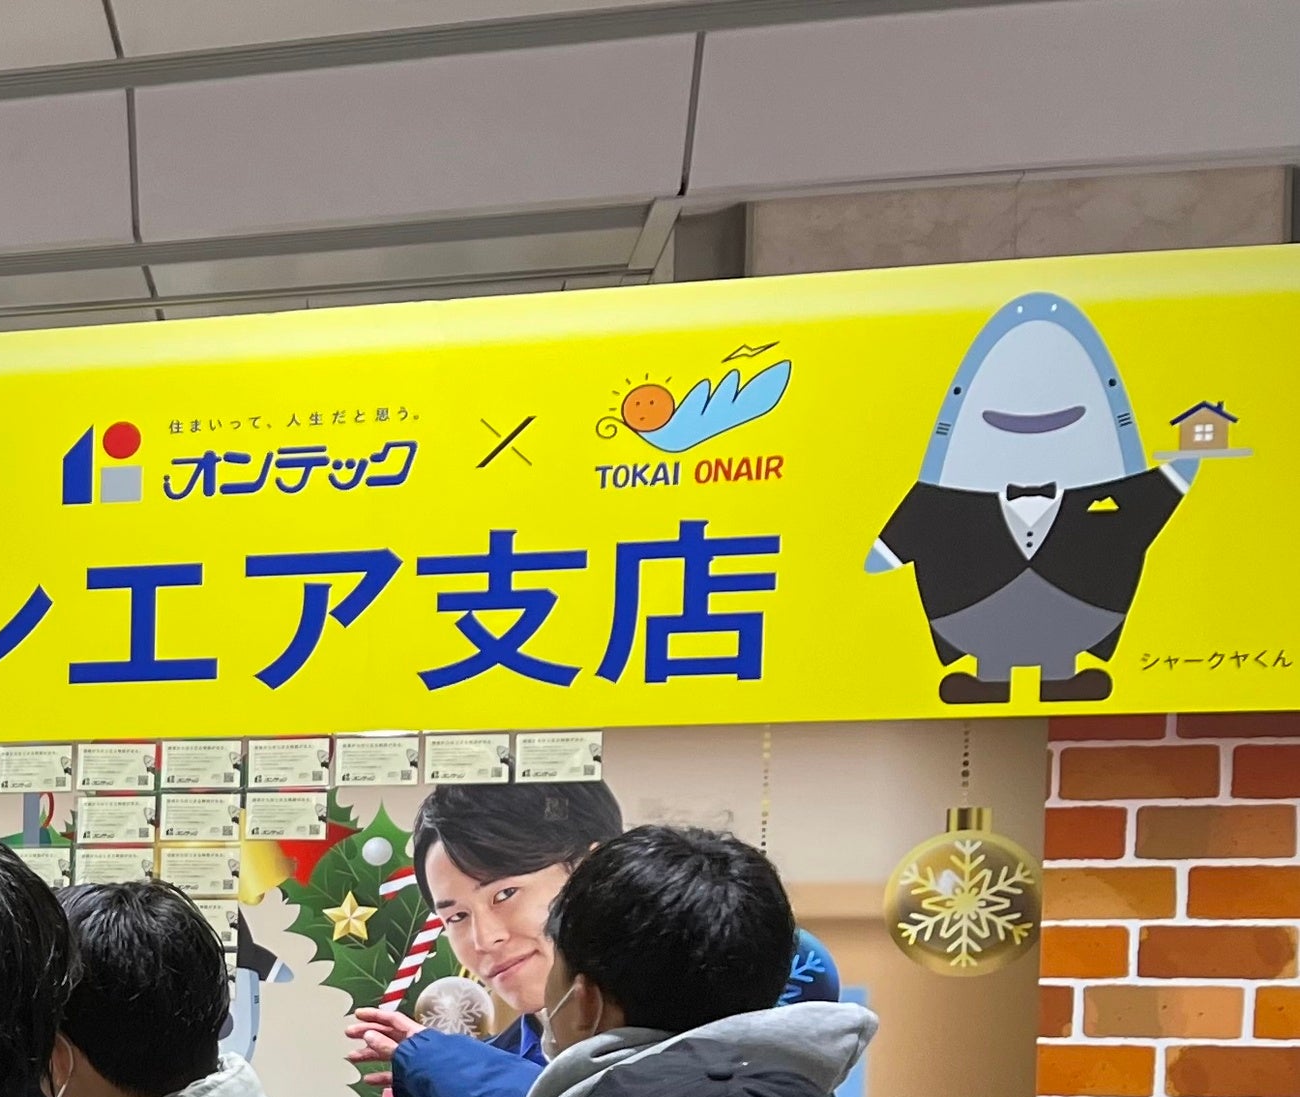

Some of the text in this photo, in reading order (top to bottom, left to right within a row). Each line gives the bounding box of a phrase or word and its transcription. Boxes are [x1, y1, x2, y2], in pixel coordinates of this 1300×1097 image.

[169, 405, 420, 434] 住まいって、人生だと思う。
[163, 440, 418, 500] オンテック
[595, 455, 784, 489] TOKAI ONAIR
[1141, 649, 1294, 671] シャークヤくん
